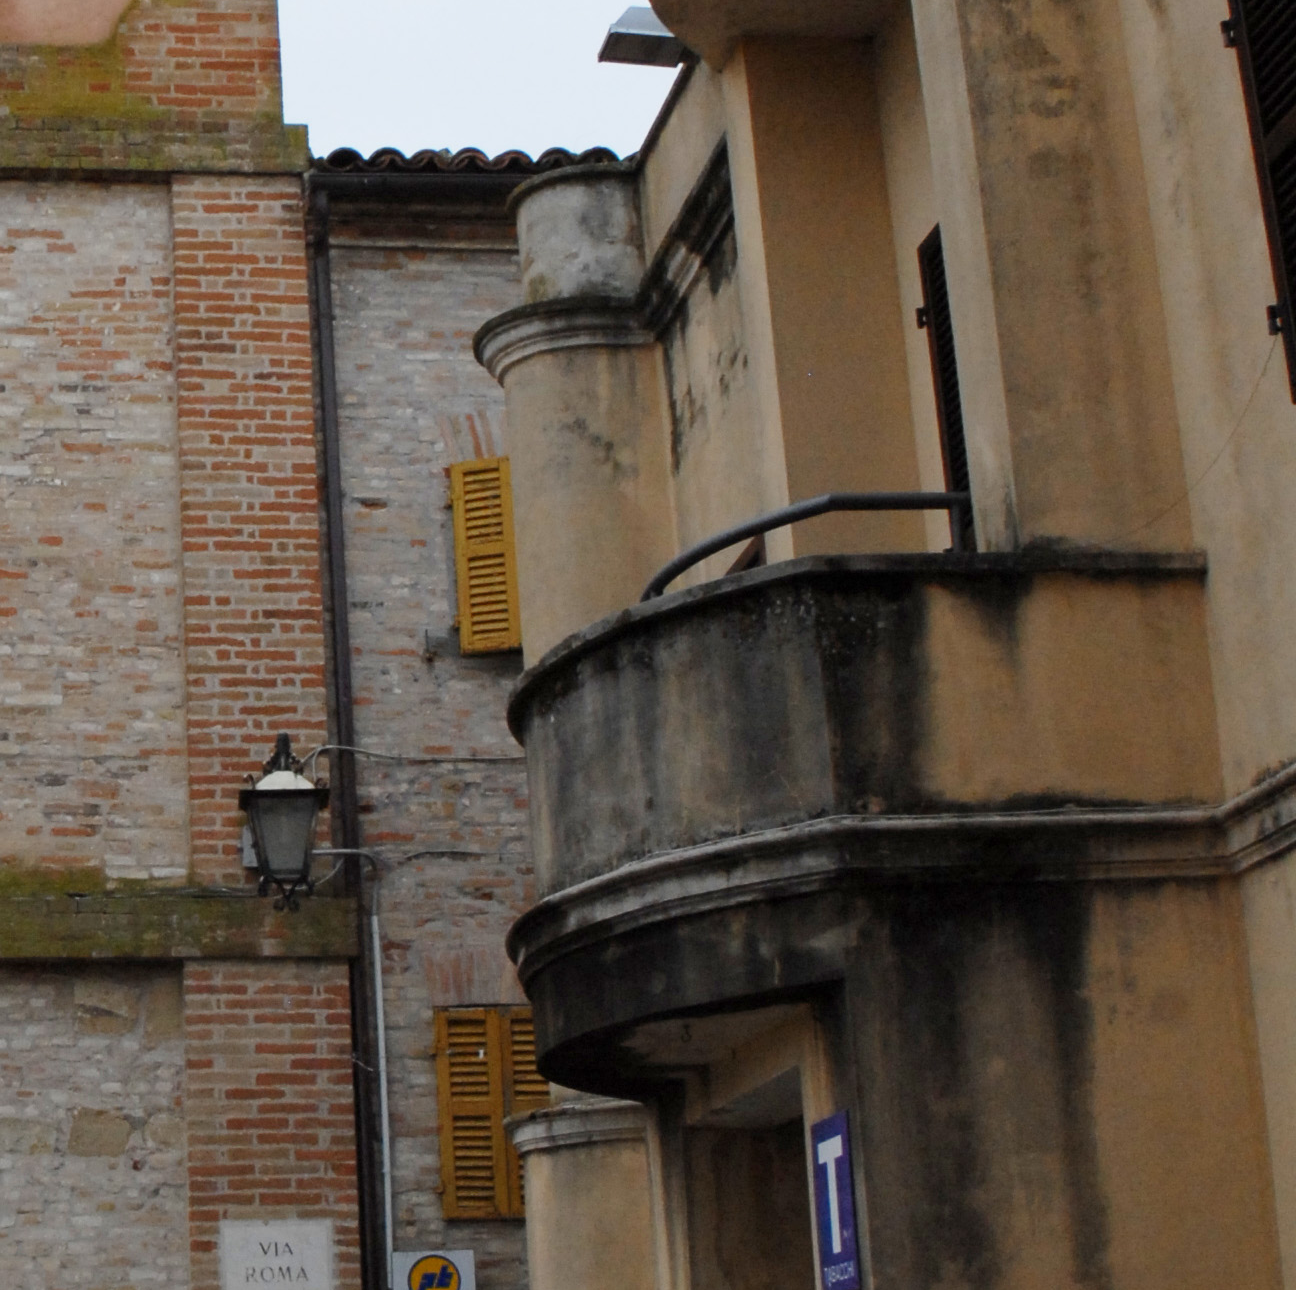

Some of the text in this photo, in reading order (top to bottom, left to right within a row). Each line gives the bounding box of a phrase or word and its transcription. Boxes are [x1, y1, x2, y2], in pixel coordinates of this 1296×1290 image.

[817, 1134, 843, 1255] T
[258, 1241, 294, 1257] VIA
[245, 1265, 309, 1284] ROMA
